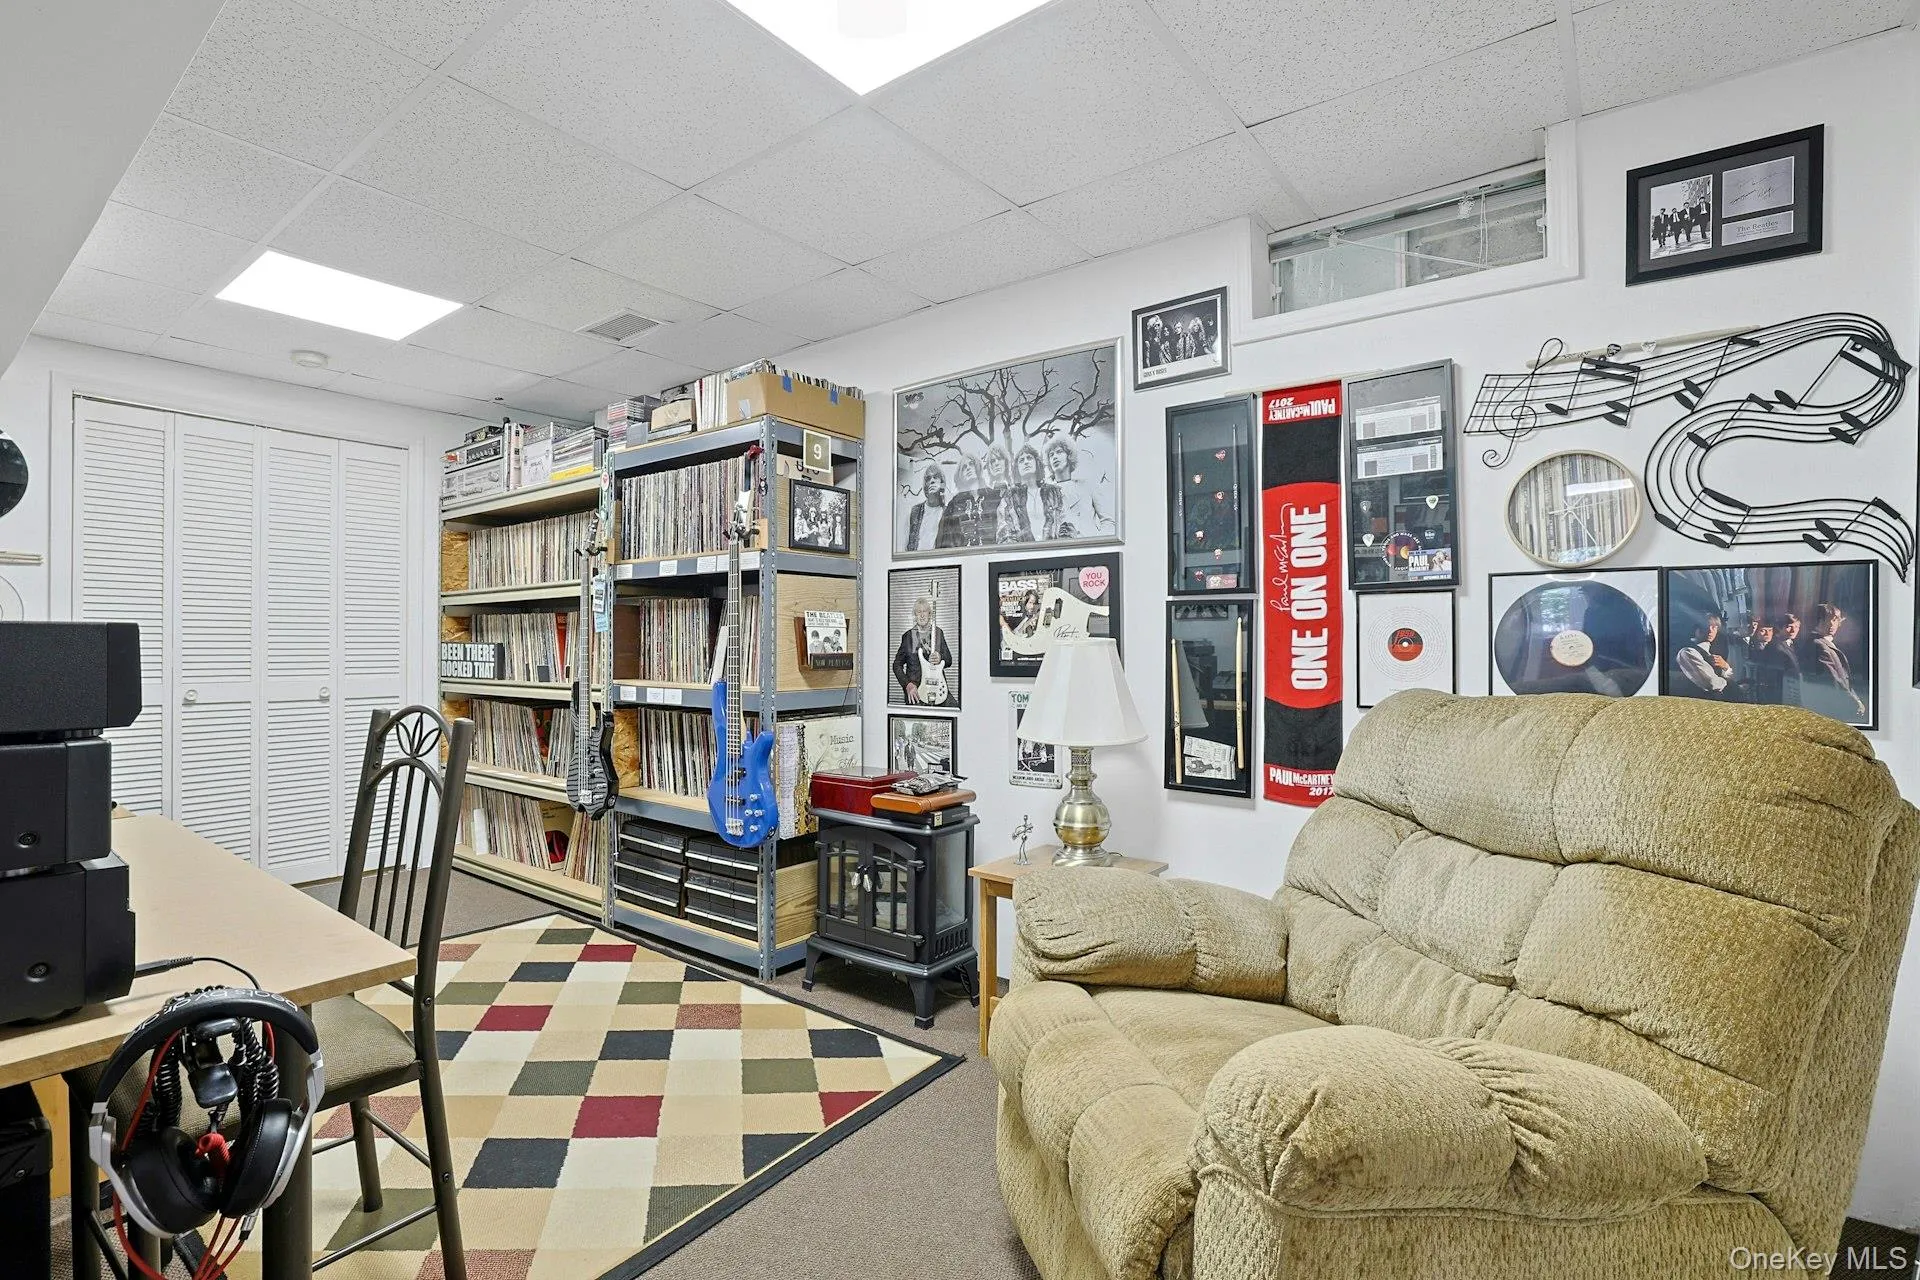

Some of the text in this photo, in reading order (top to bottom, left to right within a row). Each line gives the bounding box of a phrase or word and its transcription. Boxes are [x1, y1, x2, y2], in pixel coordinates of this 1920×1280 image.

[1736, 225, 1750, 233] The
[1752, 220, 1779, 230] Beatles
[1268, 397, 1295, 408] 2017
[1308, 398, 1336, 417] PAUL
[1268, 405, 1311, 421] McCARTNEY
[814, 444, 822, 460] 9
[1408, 554, 1429, 567] PAUL
[1085, 572, 1103, 580] YOU
[999, 579, 1038, 592] BASS
[1082, 579, 1106, 588] ROCK
[1290, 503, 1328, 690] ONE ON ONE
[441, 643, 495, 662] BEEN THERE
[441, 660, 495, 679] ROCKED THAT
[1011, 693, 1029, 703] TOM
[830, 733, 854, 746] Music
[1269, 767, 1334, 787] PAUL McCARTNEY
[1308, 786, 1335, 797] 2017
[195, 988, 229, 1001] by
[232, 989, 298, 1012] beats
